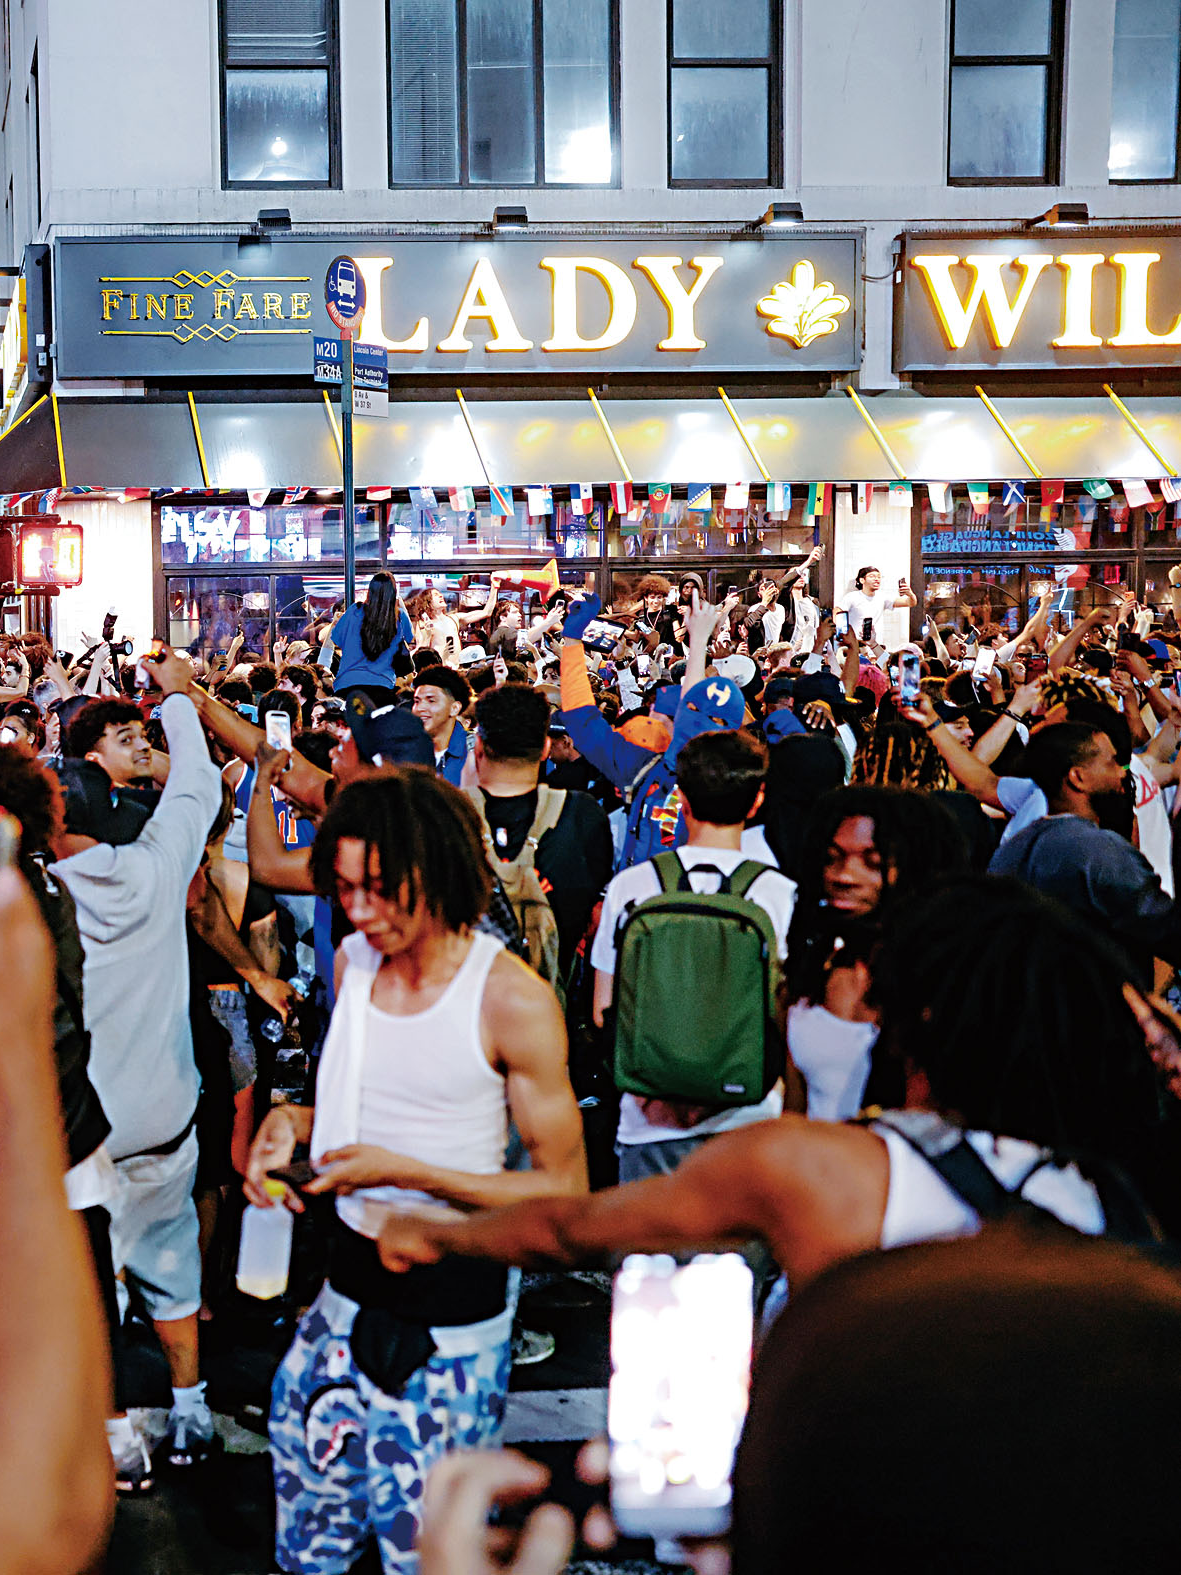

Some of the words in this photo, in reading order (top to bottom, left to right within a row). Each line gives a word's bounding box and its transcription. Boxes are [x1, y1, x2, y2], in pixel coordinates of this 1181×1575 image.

[100, 289, 194, 320] FINE
[212, 288, 311, 320] FARE
[356, 256, 724, 353] LADY
[908, 253, 1181, 350] WIL
[330, 303, 339, 319] NO
[316, 342, 337, 358] M20
[354, 345, 369, 355] Lincoln
[370, 348, 384, 357] Center
[317, 364, 342, 381] M34A
[355, 367, 364, 376] Port
[364, 368, 384, 378] Authority
